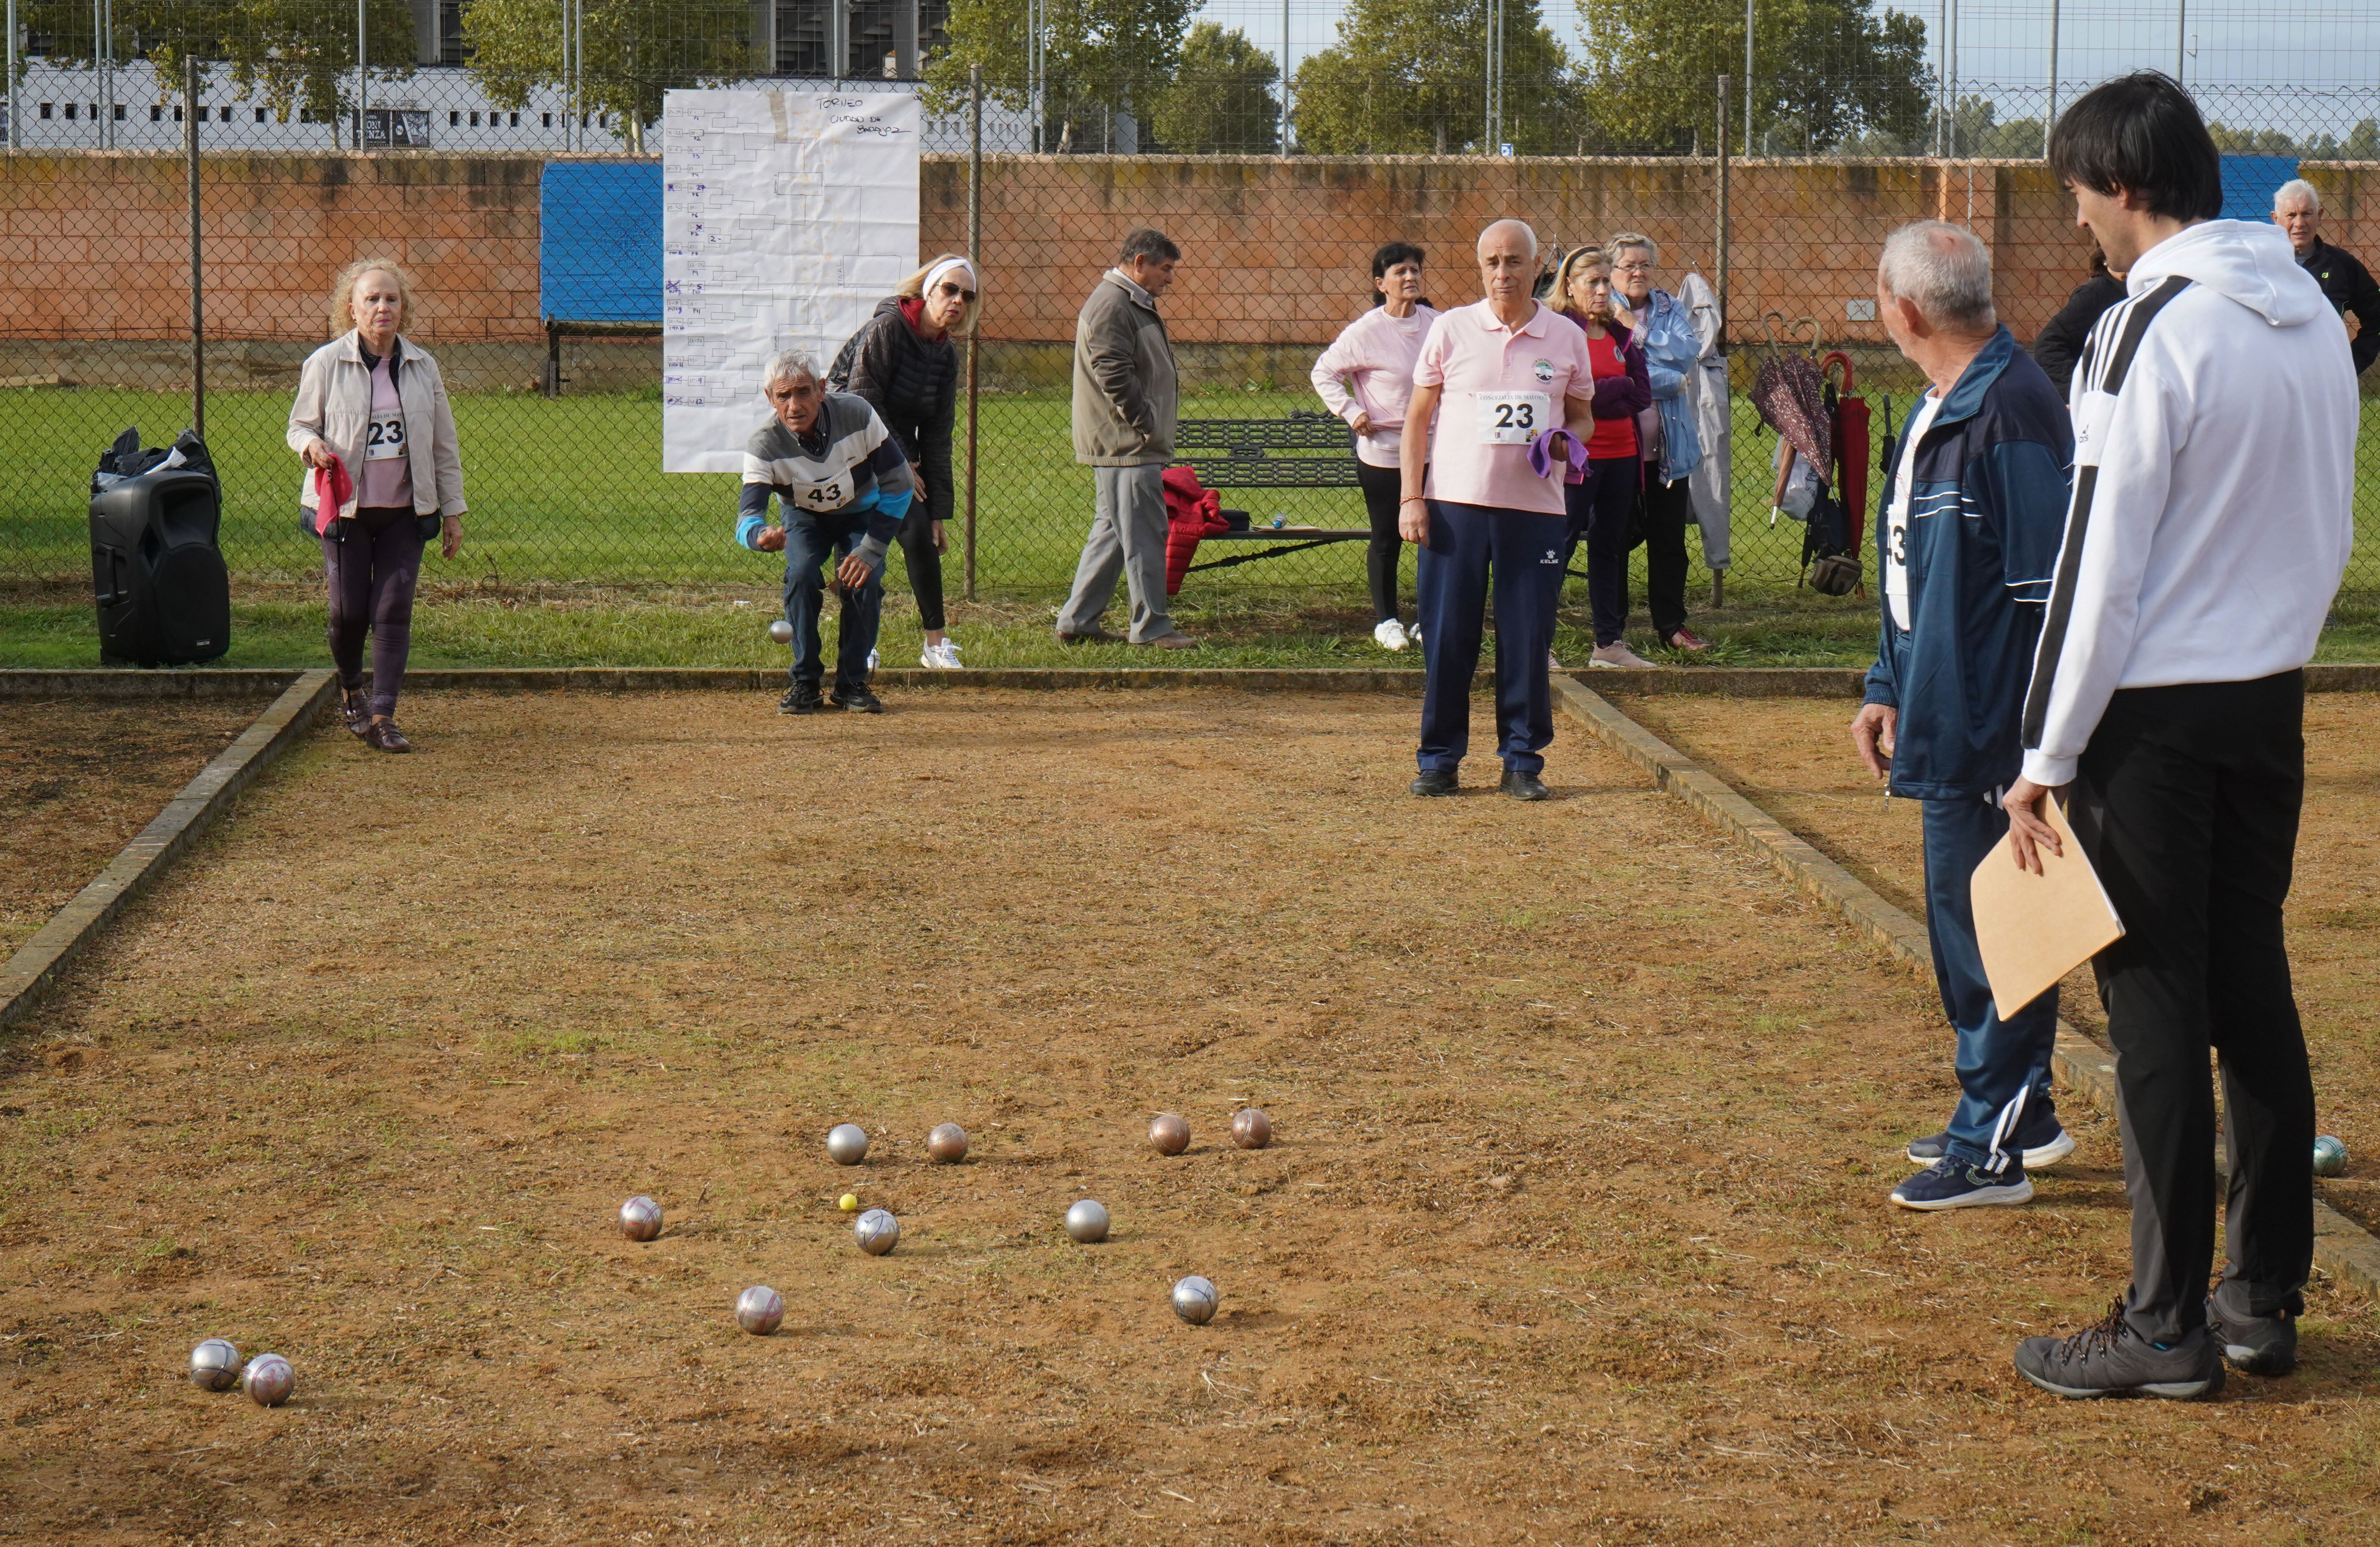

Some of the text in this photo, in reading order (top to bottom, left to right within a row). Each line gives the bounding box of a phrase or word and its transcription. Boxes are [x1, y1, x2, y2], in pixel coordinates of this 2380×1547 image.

[816, 97, 863, 109] TORNEO
[831, 115, 864, 123] CIUDAD
[857, 125, 912, 136] BADAJOZ
[1495, 403, 1533, 429] 23
[368, 420, 403, 446] 23
[808, 483, 842, 503] 43
